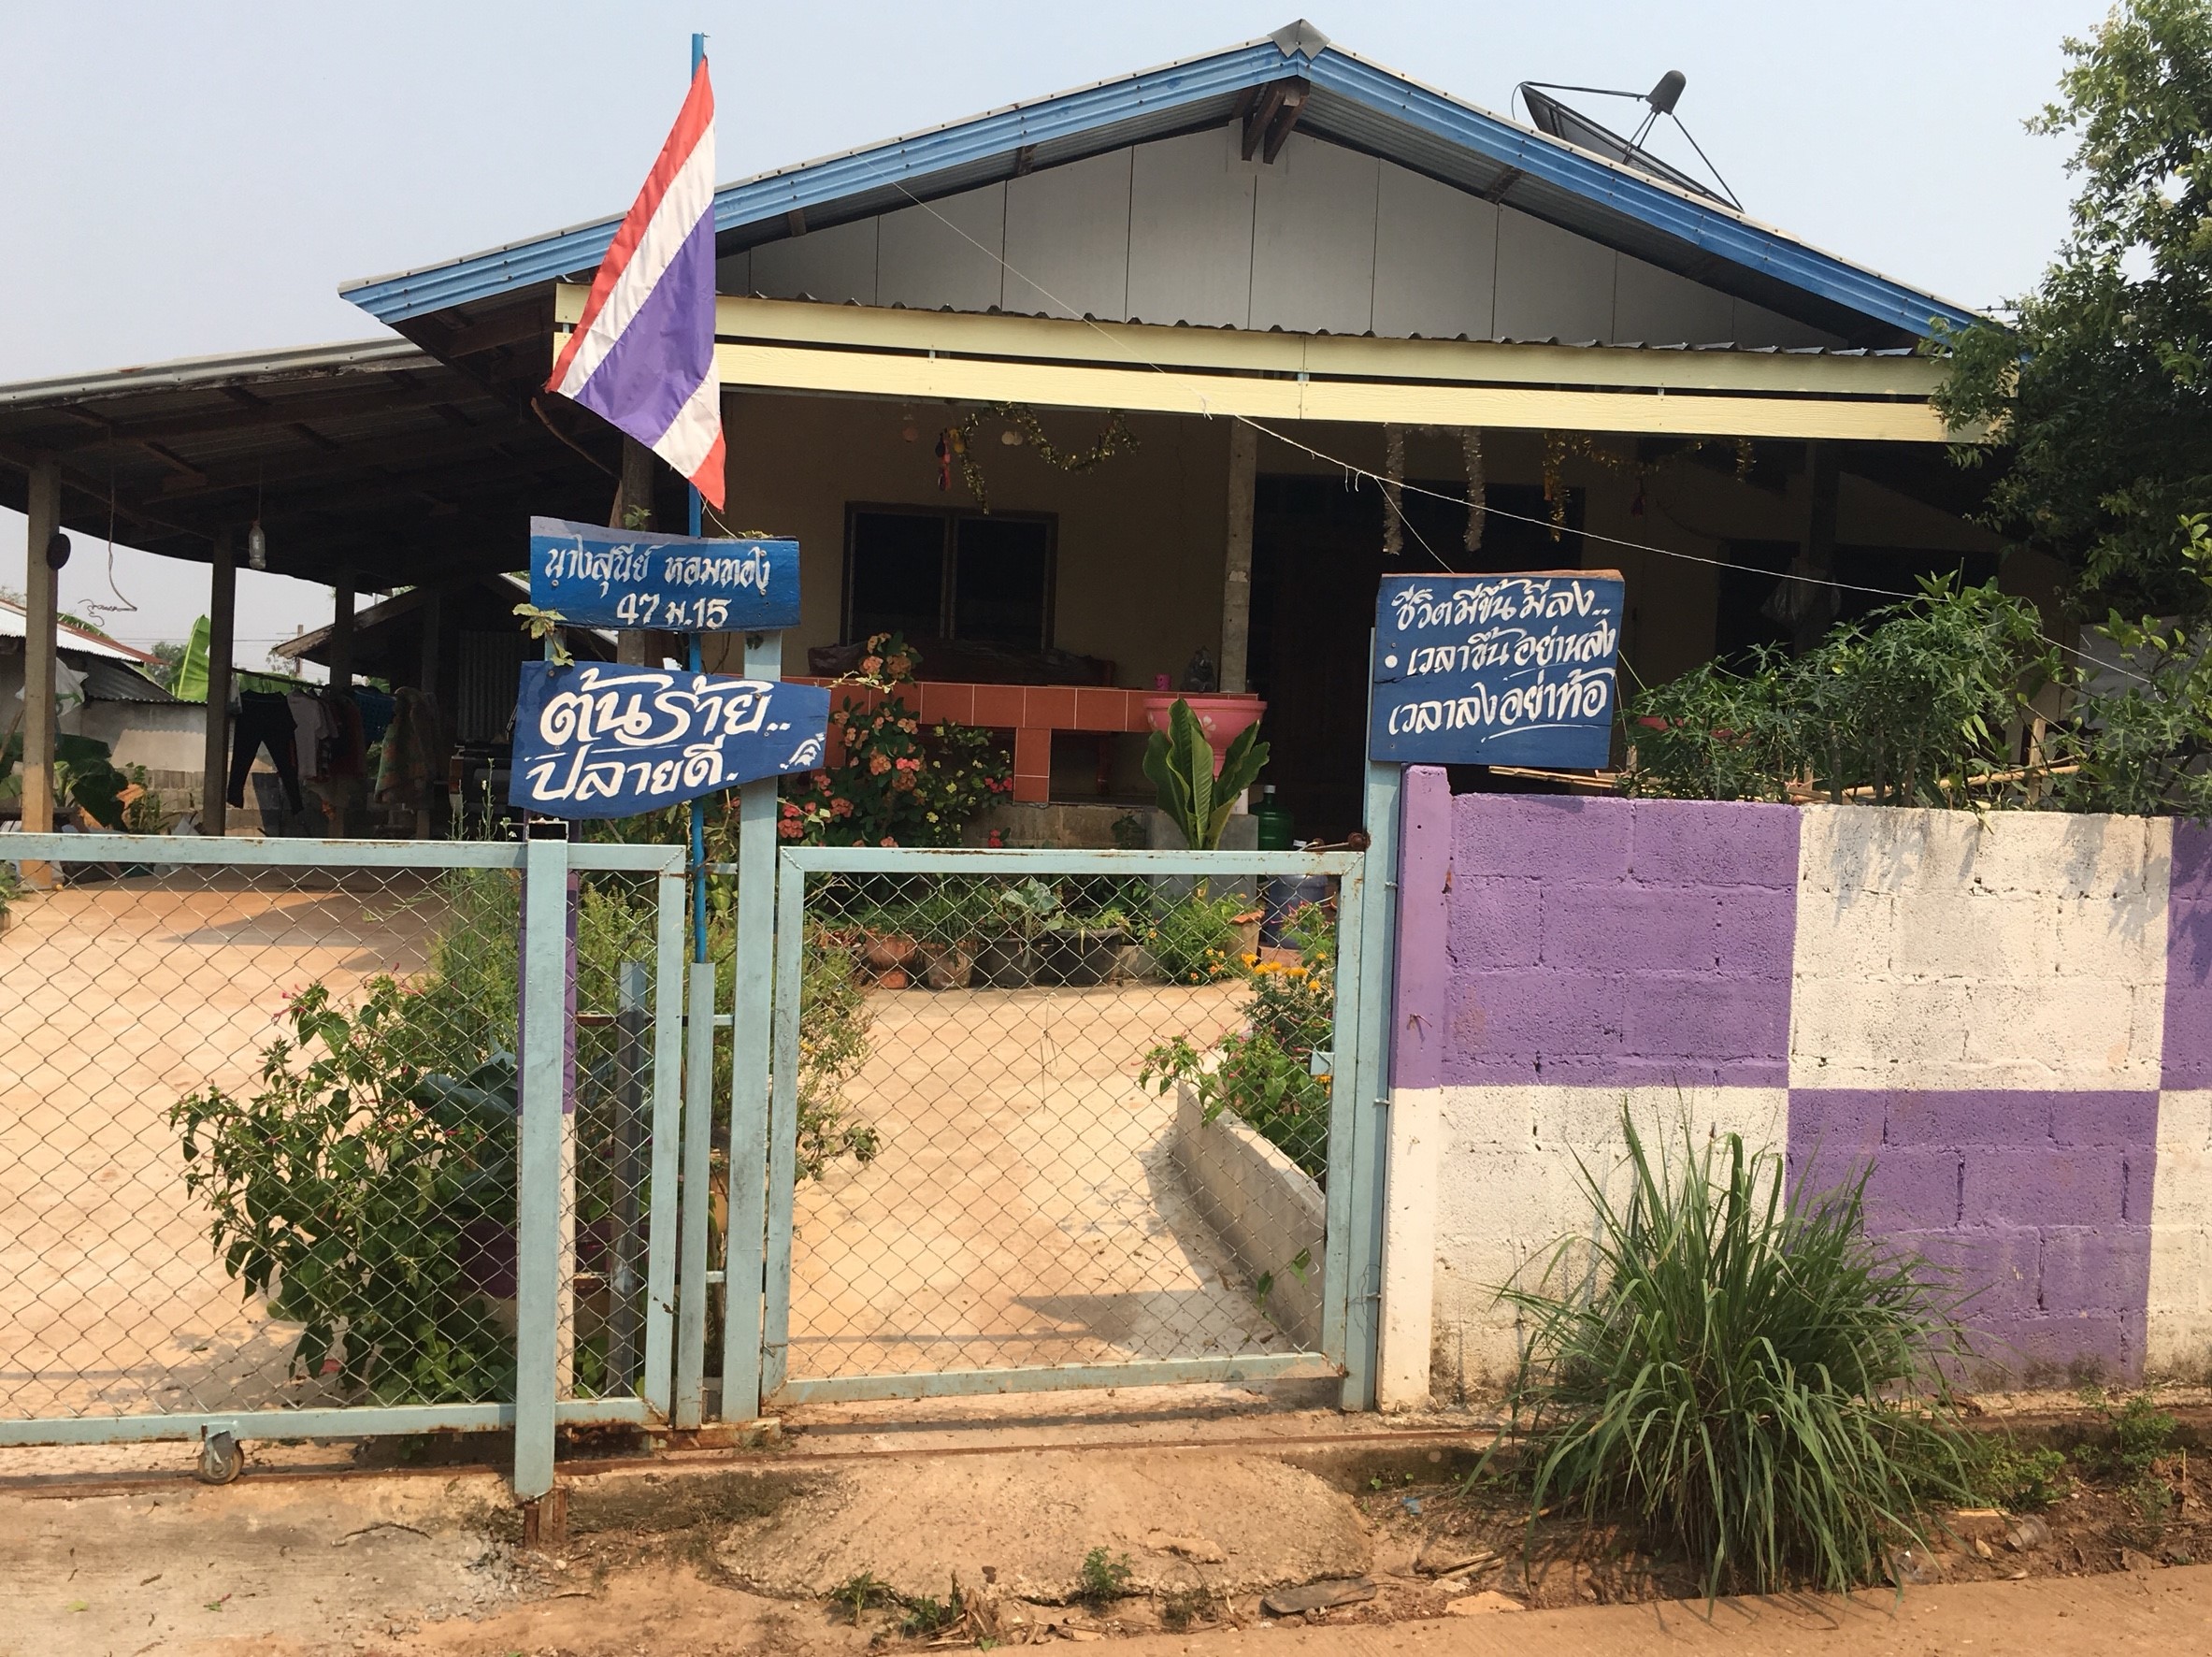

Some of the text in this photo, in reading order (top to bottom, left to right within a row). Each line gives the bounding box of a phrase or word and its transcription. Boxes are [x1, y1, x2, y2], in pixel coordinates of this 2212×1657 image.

[665, 546, 771, 589] หอมทอง
[616, 593, 661, 626] 47
